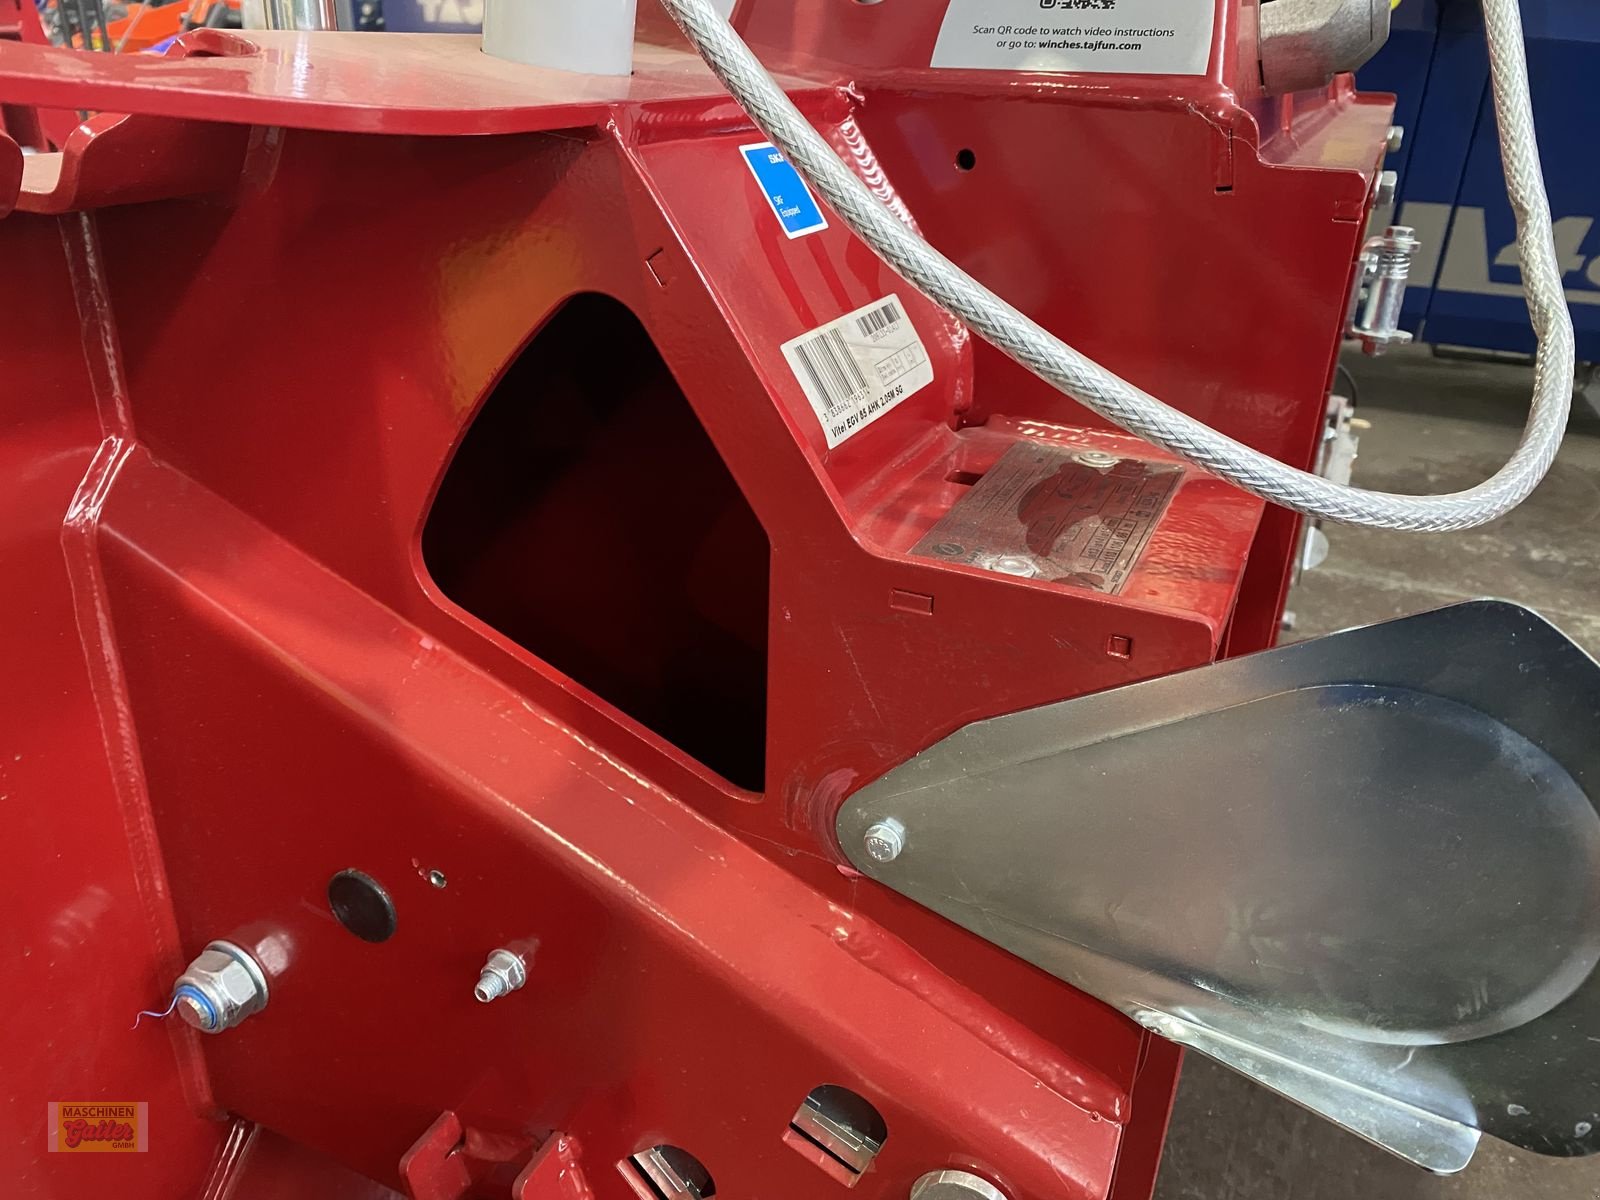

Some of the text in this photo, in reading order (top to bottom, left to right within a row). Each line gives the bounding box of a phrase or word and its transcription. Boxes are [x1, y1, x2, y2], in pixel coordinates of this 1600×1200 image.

[973, 25, 1175, 37] Scan QR code to watch video instructions
[996, 39, 1142, 52] or go to: winches.tajfun.com
[846, 412, 860, 429] EGV
[867, 400, 881, 415] AHK
[880, 389, 896, 407] 2.05M
[895, 384, 904, 396] SG
